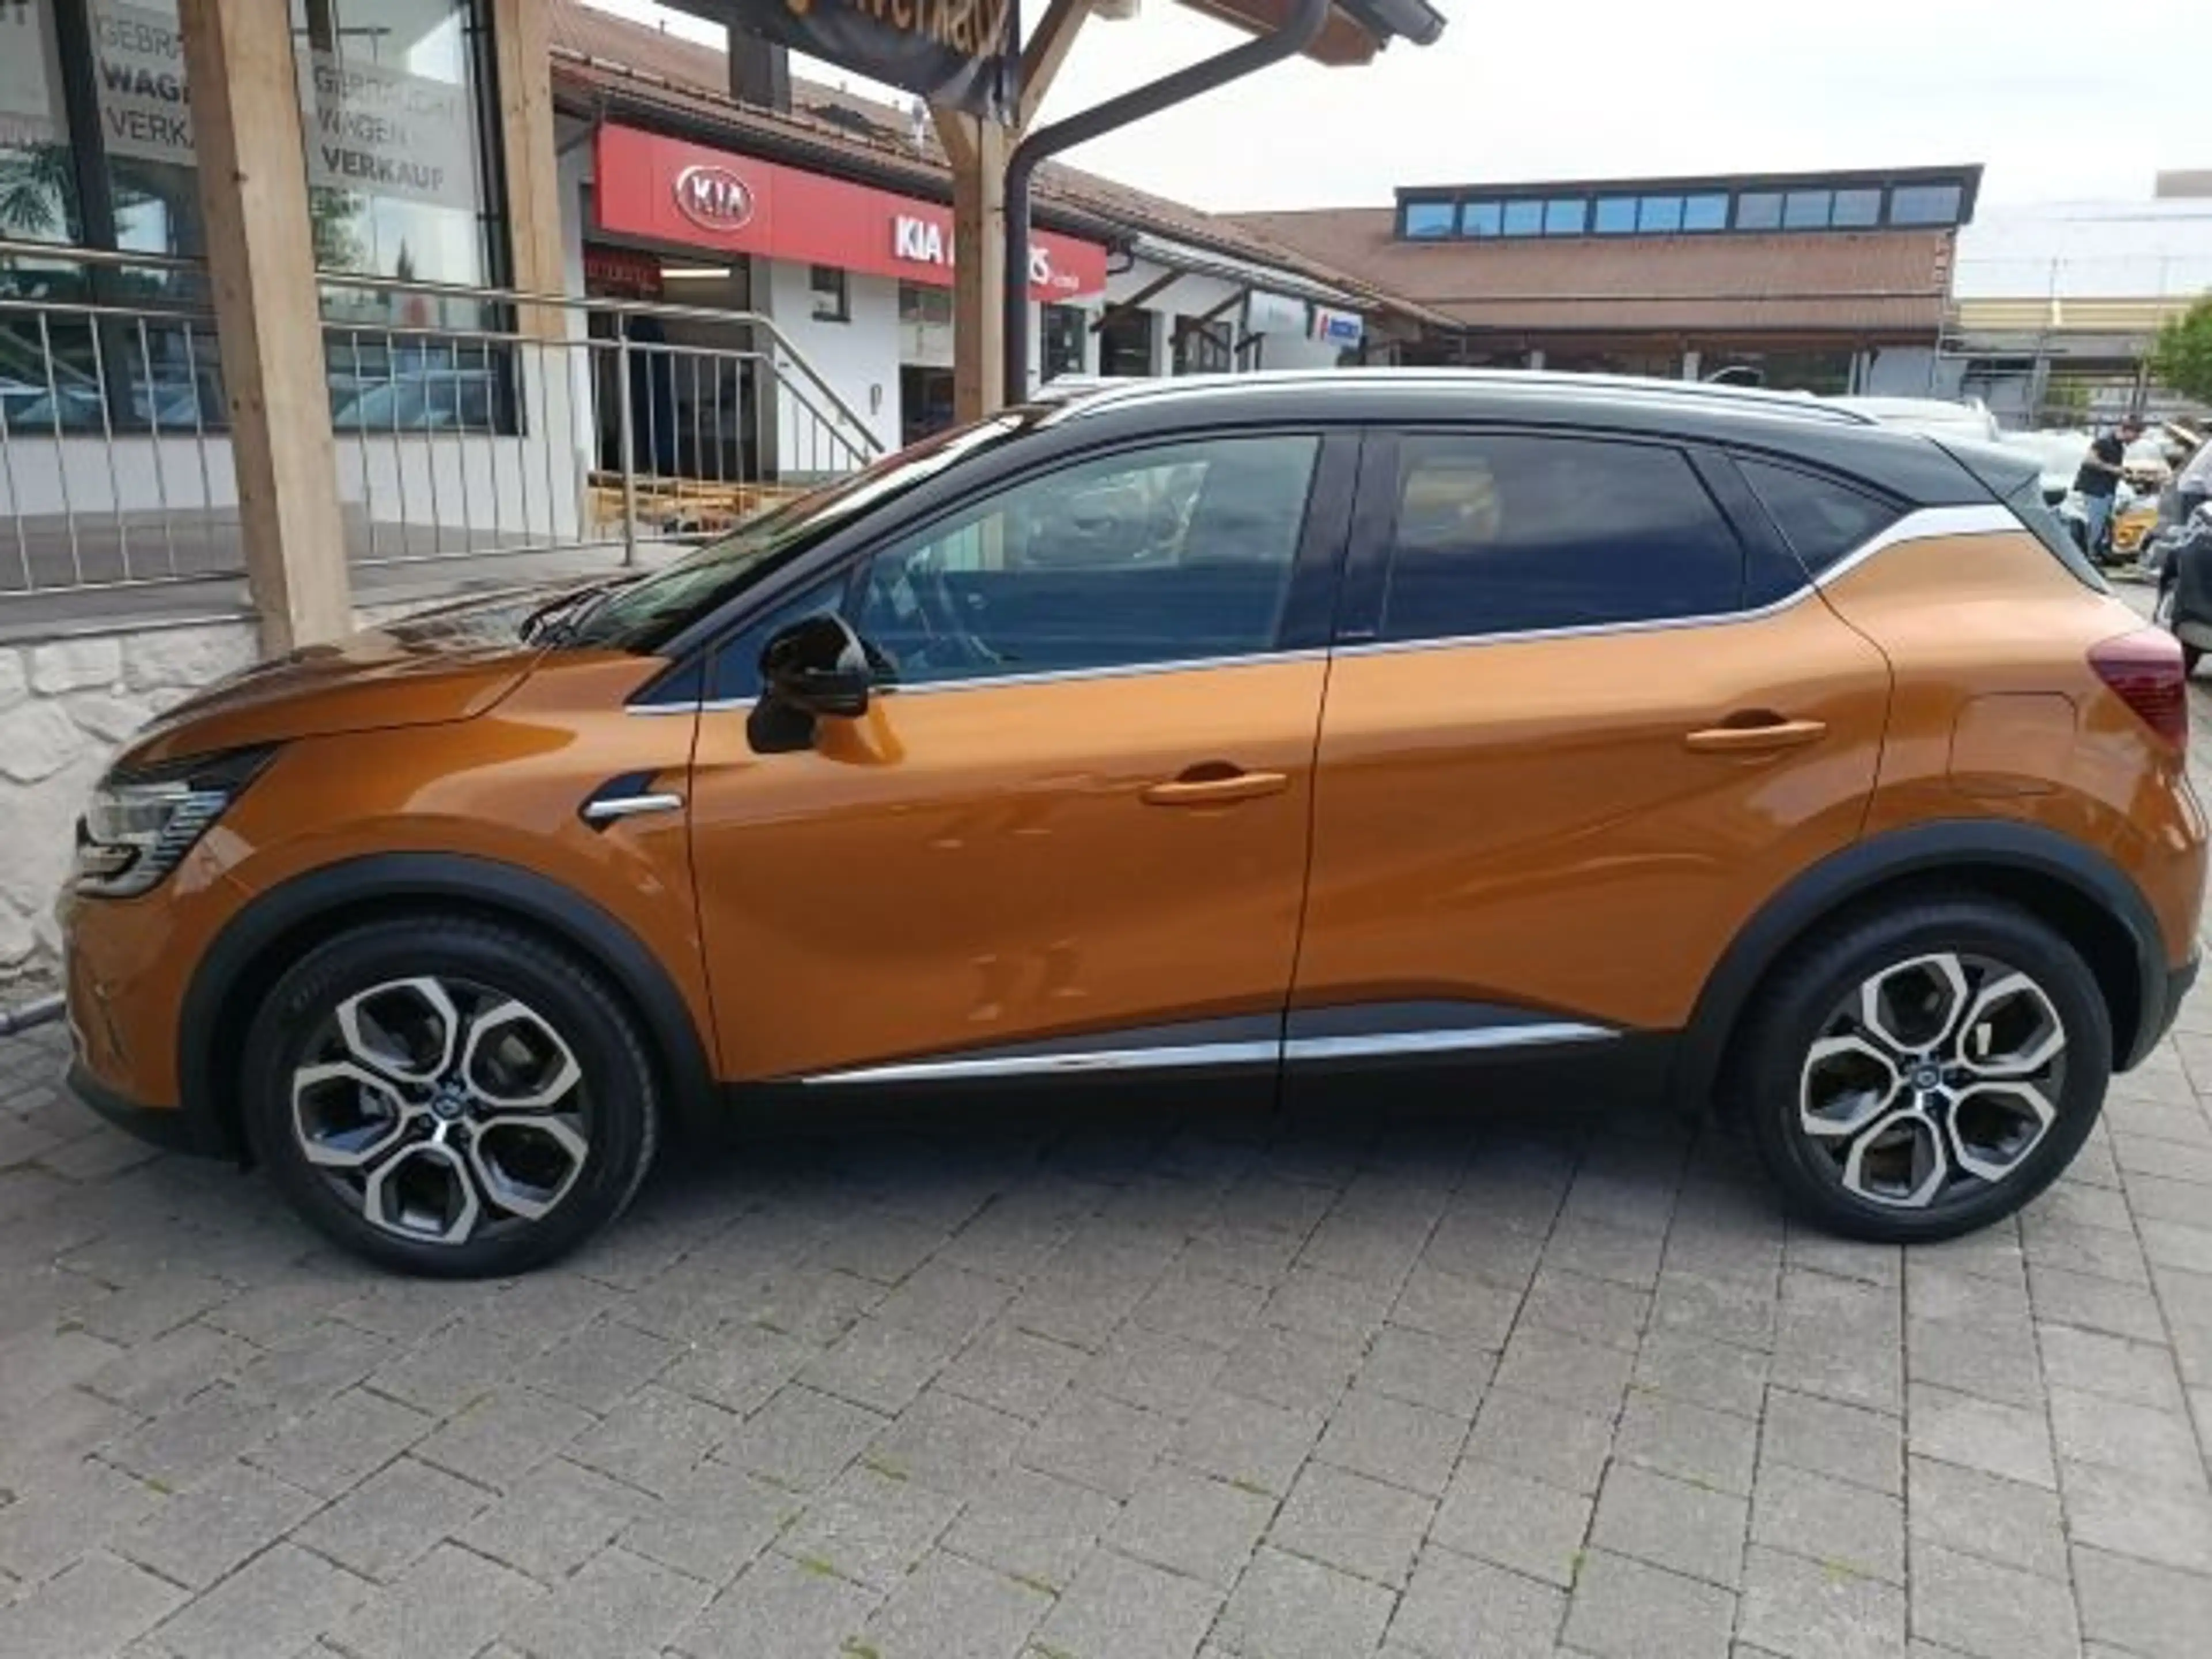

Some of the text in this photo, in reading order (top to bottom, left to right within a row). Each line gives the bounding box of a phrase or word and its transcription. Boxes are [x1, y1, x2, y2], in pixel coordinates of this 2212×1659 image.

[105, 105, 195, 149] VERK
[320, 144, 444, 192] VERKAUF
[692, 175, 747, 219] KIA
[897, 214, 944, 266] KIA
